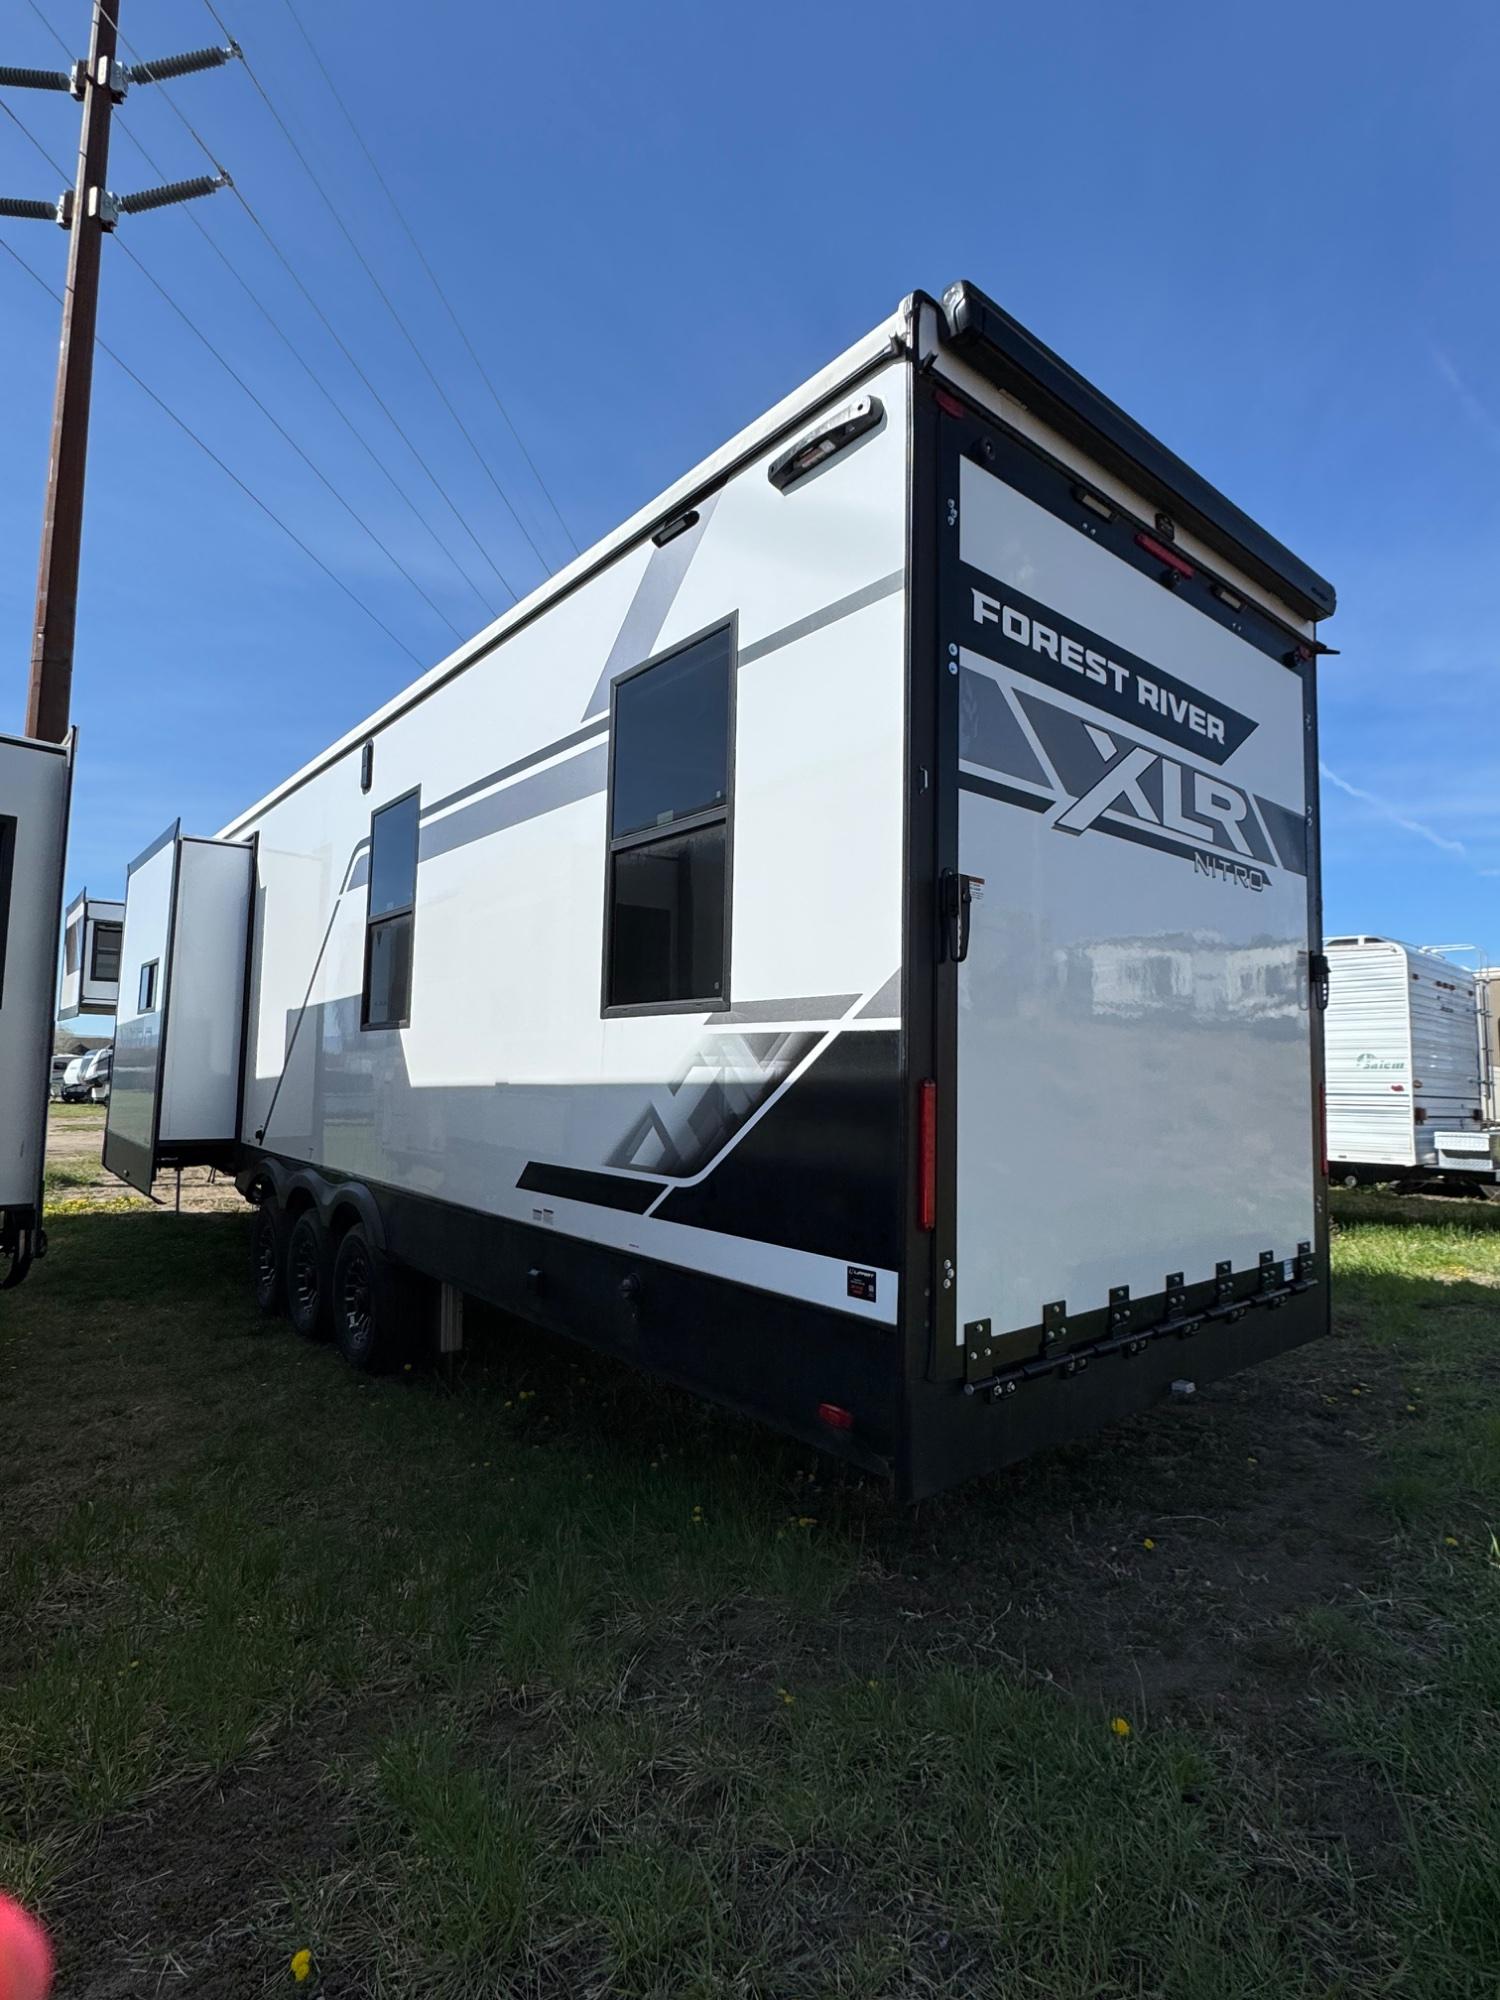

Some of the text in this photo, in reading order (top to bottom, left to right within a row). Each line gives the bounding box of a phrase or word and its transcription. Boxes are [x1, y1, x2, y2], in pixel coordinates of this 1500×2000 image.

[971, 587, 1225, 744] FOREST RIVER
[1055, 722, 1254, 857] XLR
[1193, 852, 1264, 892] NITRO
